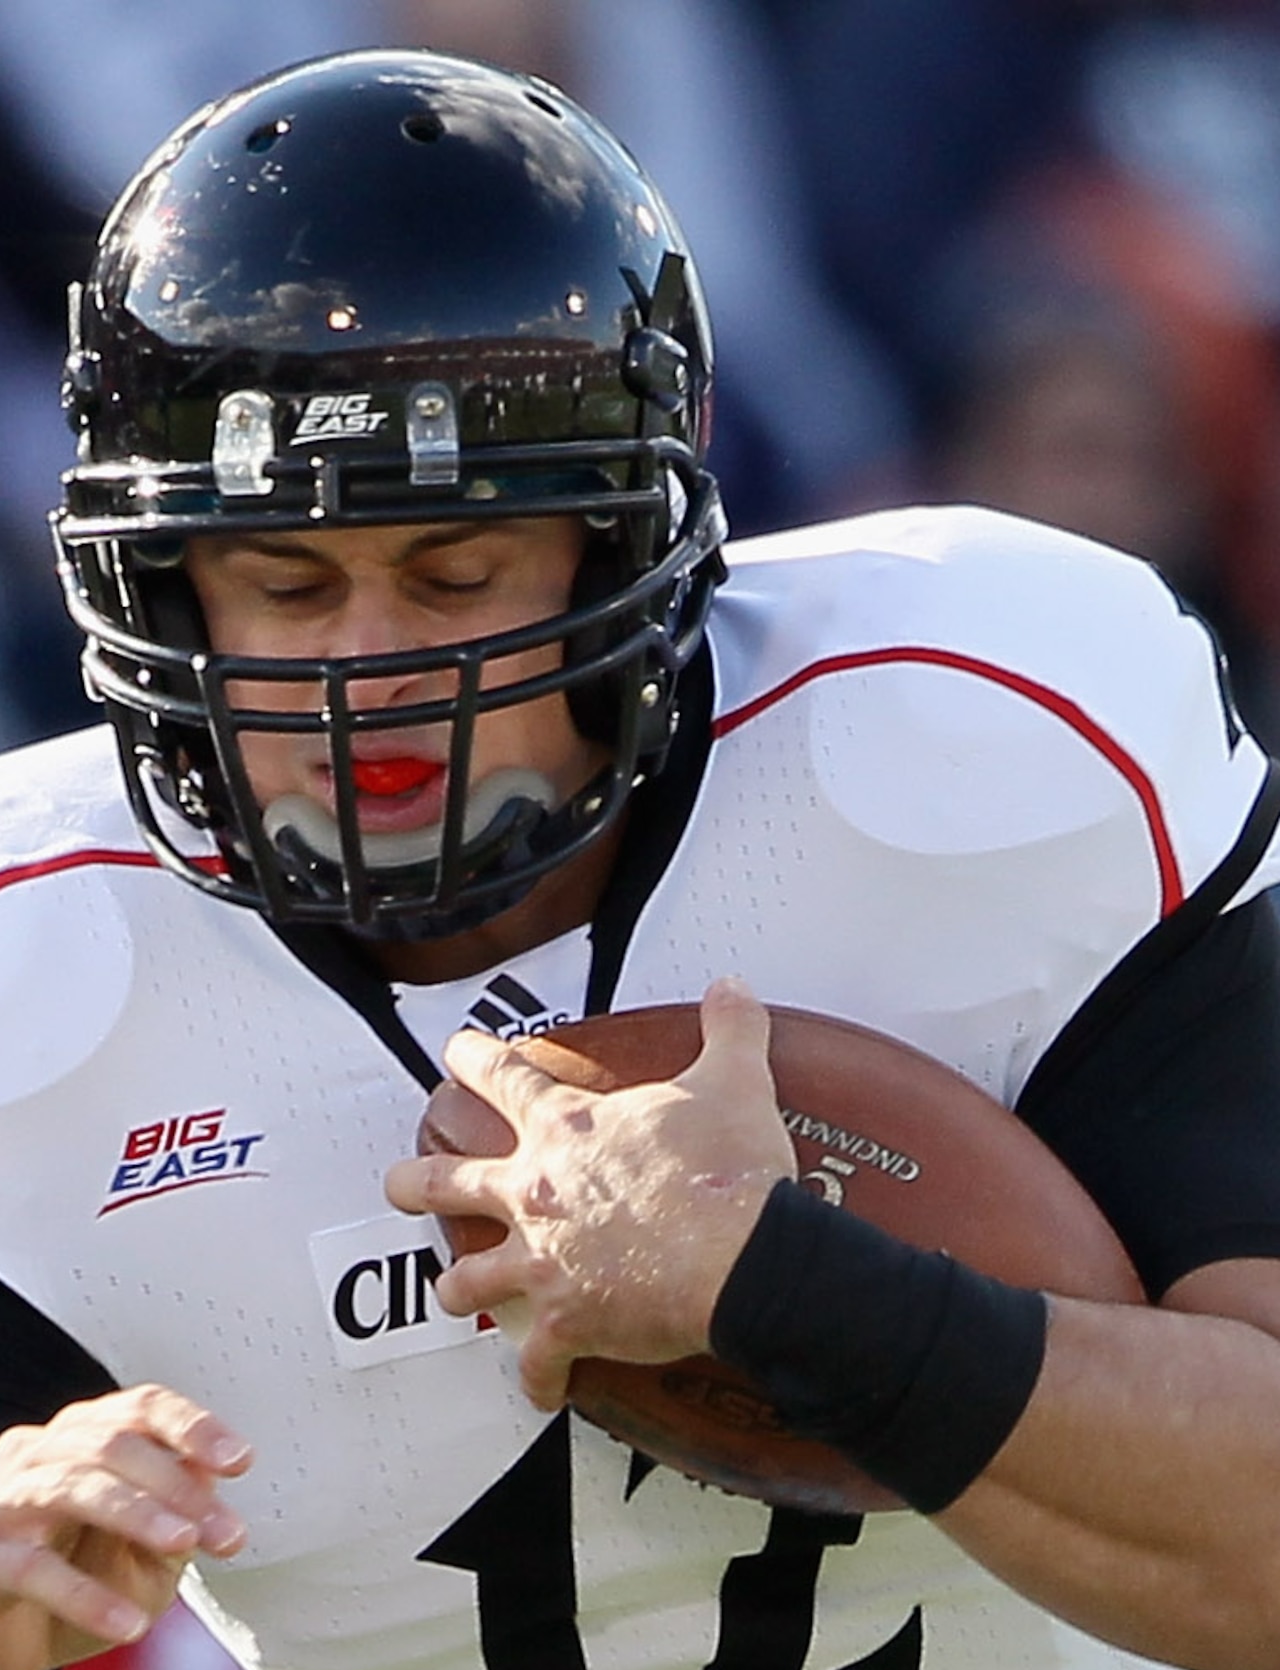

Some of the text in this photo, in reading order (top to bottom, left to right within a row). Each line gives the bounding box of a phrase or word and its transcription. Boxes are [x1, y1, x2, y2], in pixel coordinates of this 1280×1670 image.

[295, 412, 390, 436] EAST
[304, 393, 372, 416] BIG
[123, 1107, 227, 1161] BIG
[109, 1133, 266, 1193] EAST
